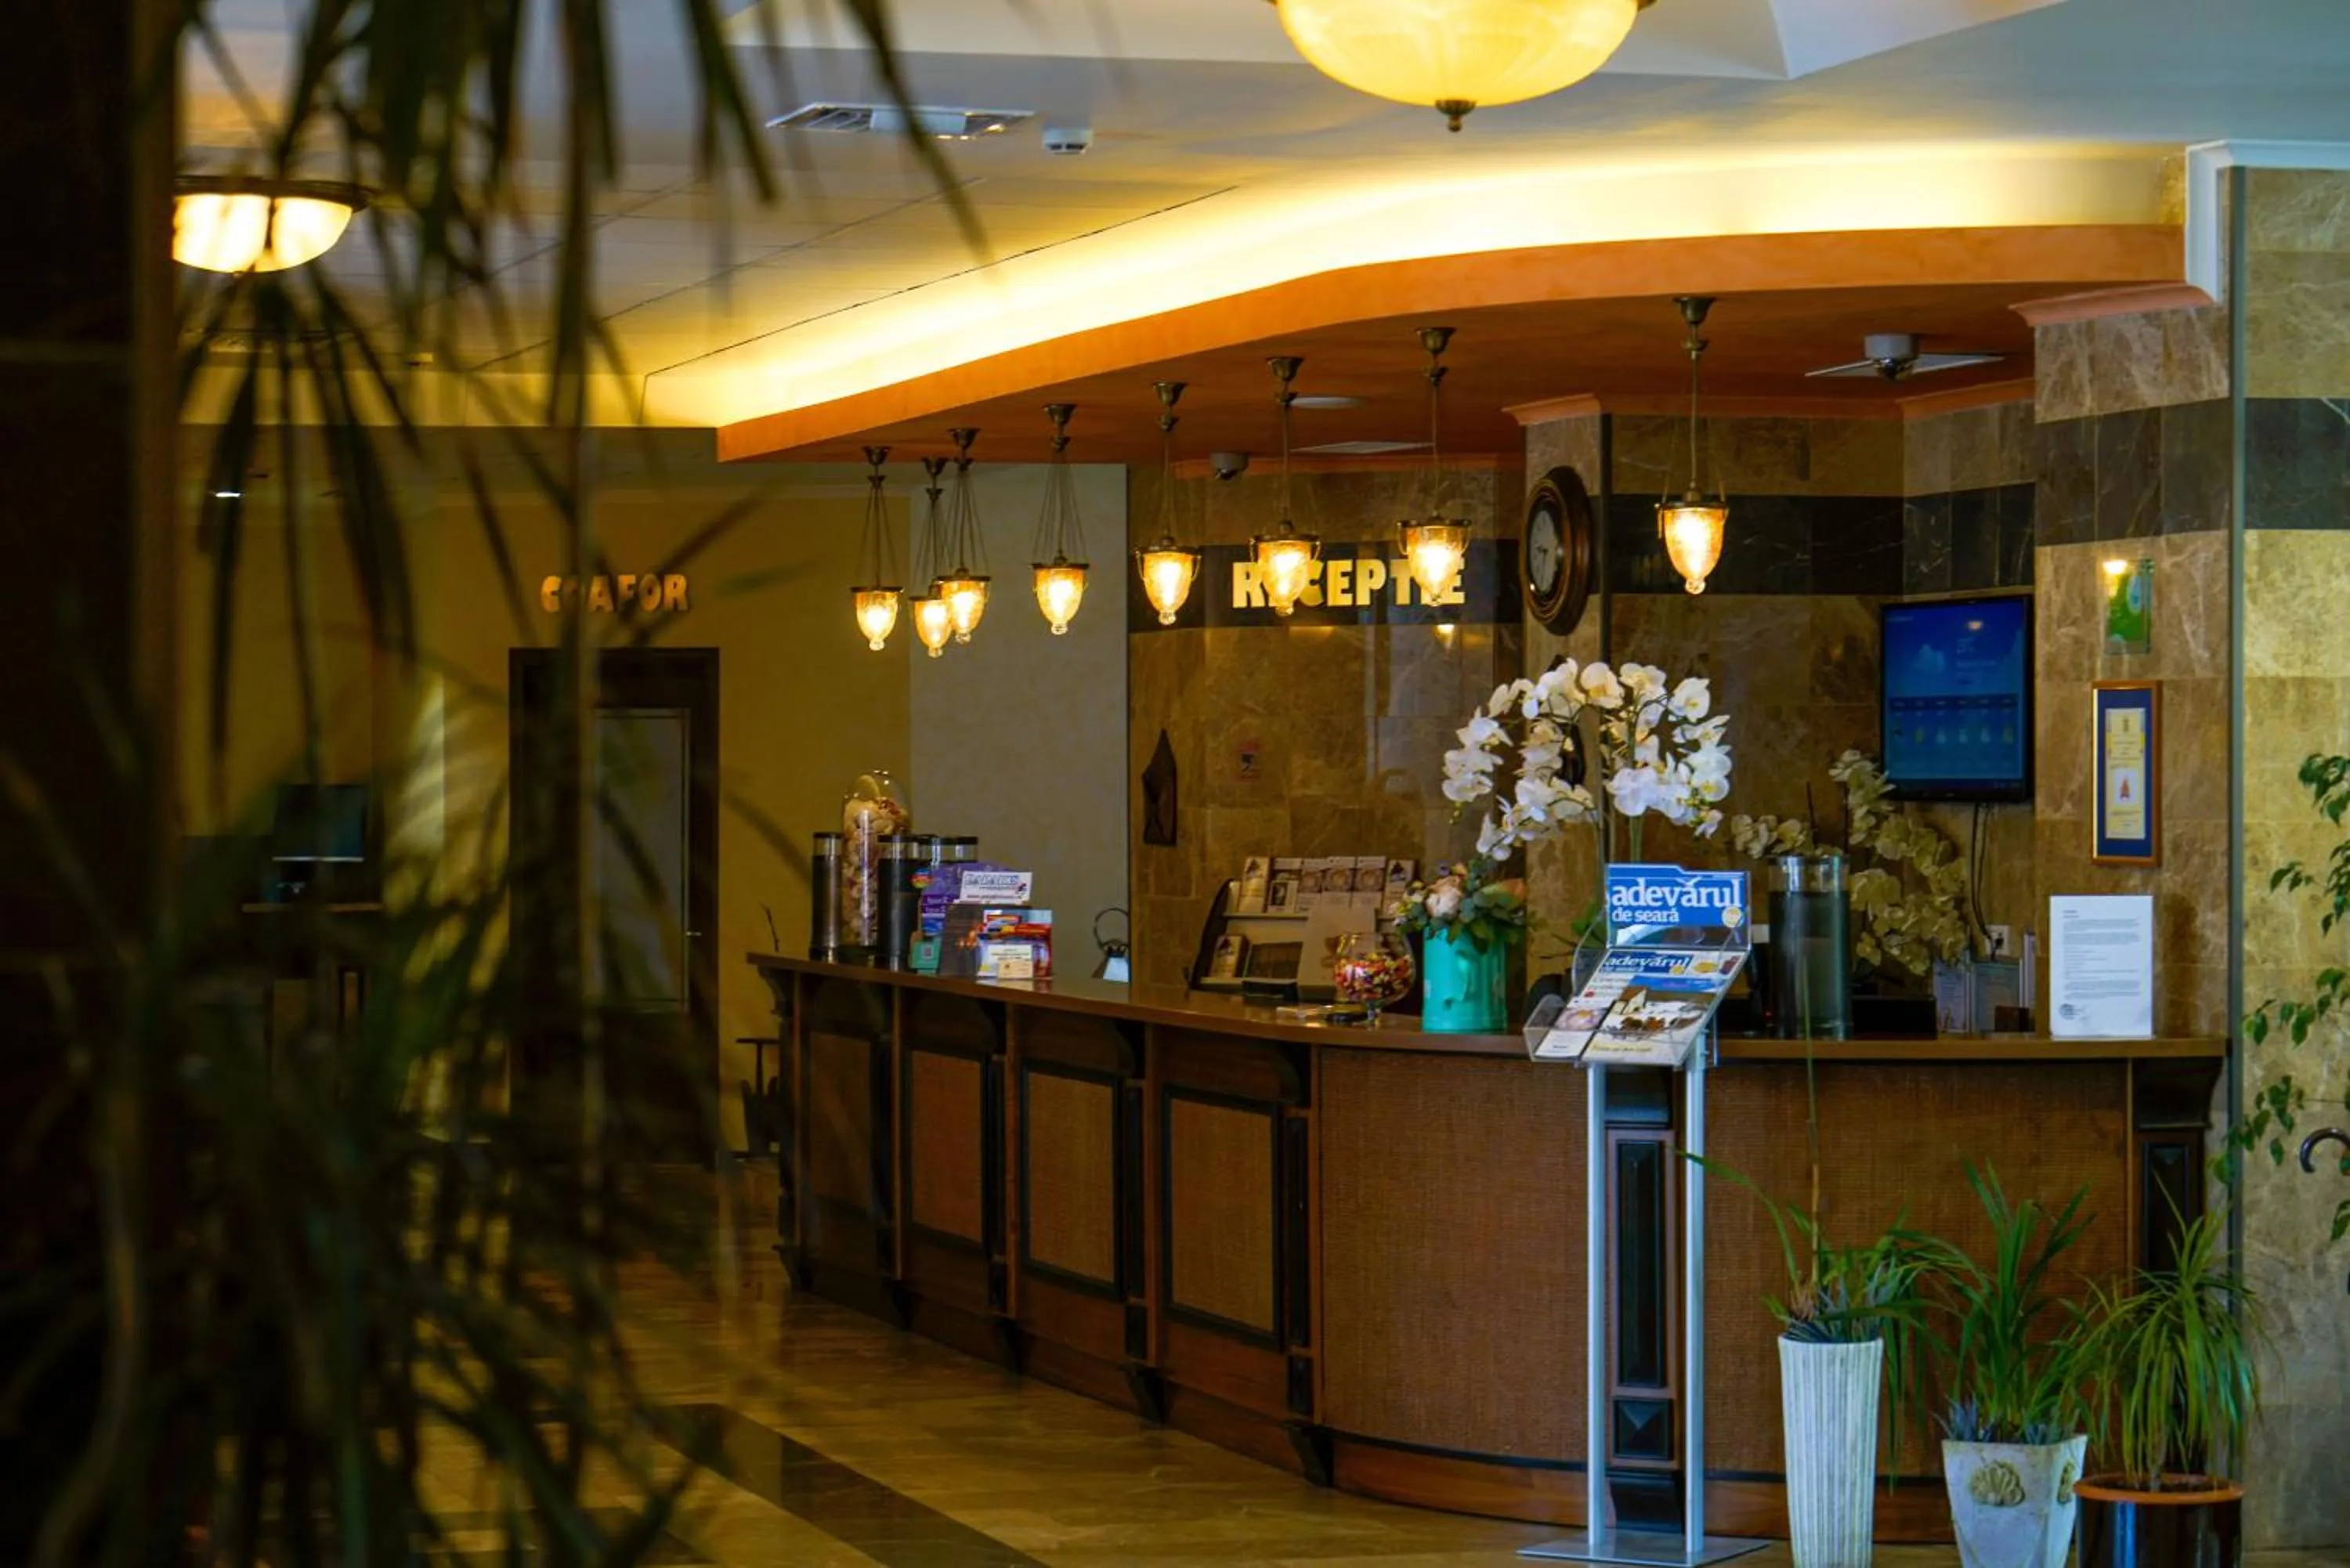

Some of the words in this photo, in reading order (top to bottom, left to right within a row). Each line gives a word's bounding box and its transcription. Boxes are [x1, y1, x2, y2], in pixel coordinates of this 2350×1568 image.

[1232, 558, 1466, 609] RCEPTE
[1611, 876, 1743, 908] adevărul
[1611, 907, 1632, 922] de
